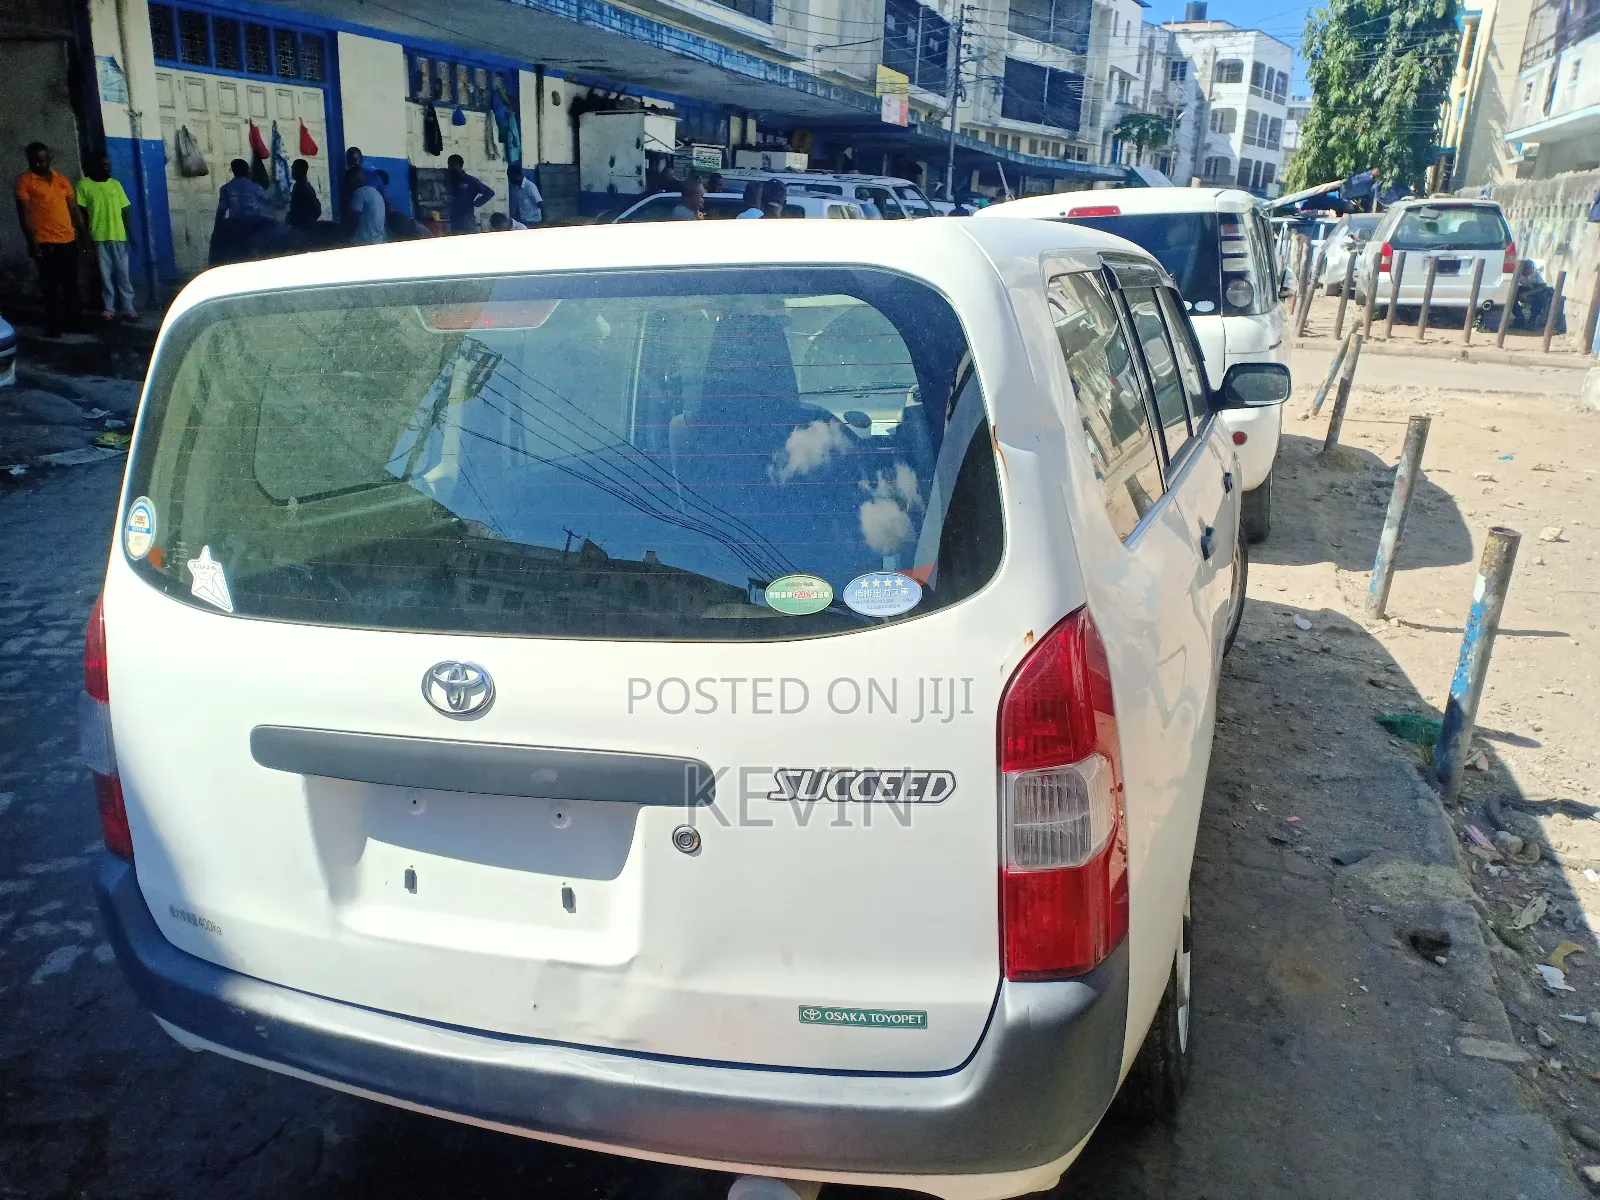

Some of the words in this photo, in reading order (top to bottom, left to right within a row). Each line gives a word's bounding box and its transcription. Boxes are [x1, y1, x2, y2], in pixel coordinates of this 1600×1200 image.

[766, 769, 957, 804] SUCCEED
[825, 1011, 867, 1022] OSAKA
[869, 1013, 923, 1024] TOYOPET
